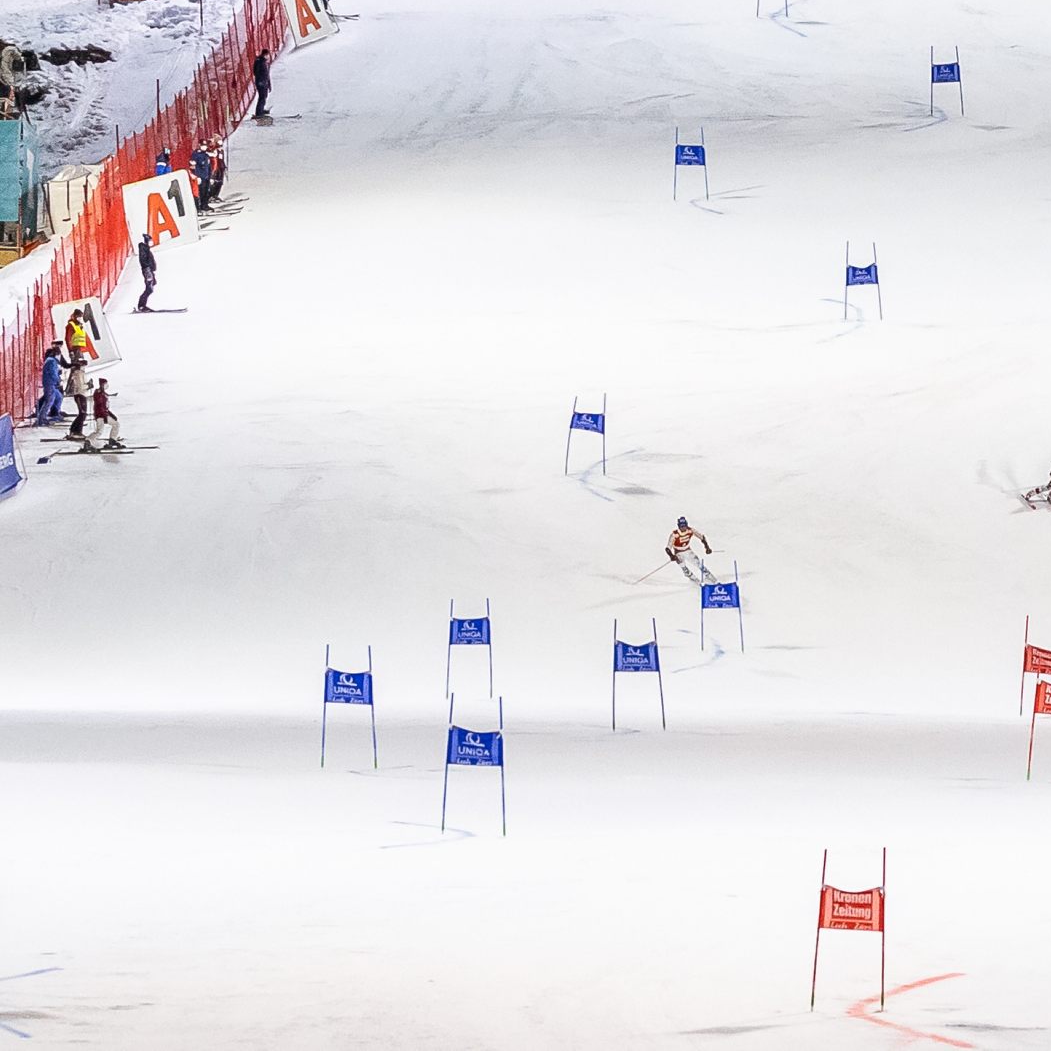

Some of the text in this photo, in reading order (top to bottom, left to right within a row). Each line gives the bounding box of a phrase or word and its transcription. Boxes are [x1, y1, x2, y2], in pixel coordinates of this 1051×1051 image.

[146, 178, 185, 246] A1
[333, 686, 362, 695] UNIQA
[458, 746, 490, 756] UNIQA
[833, 891, 871, 904] Kronen
[832, 903, 871, 919] Zeitung
